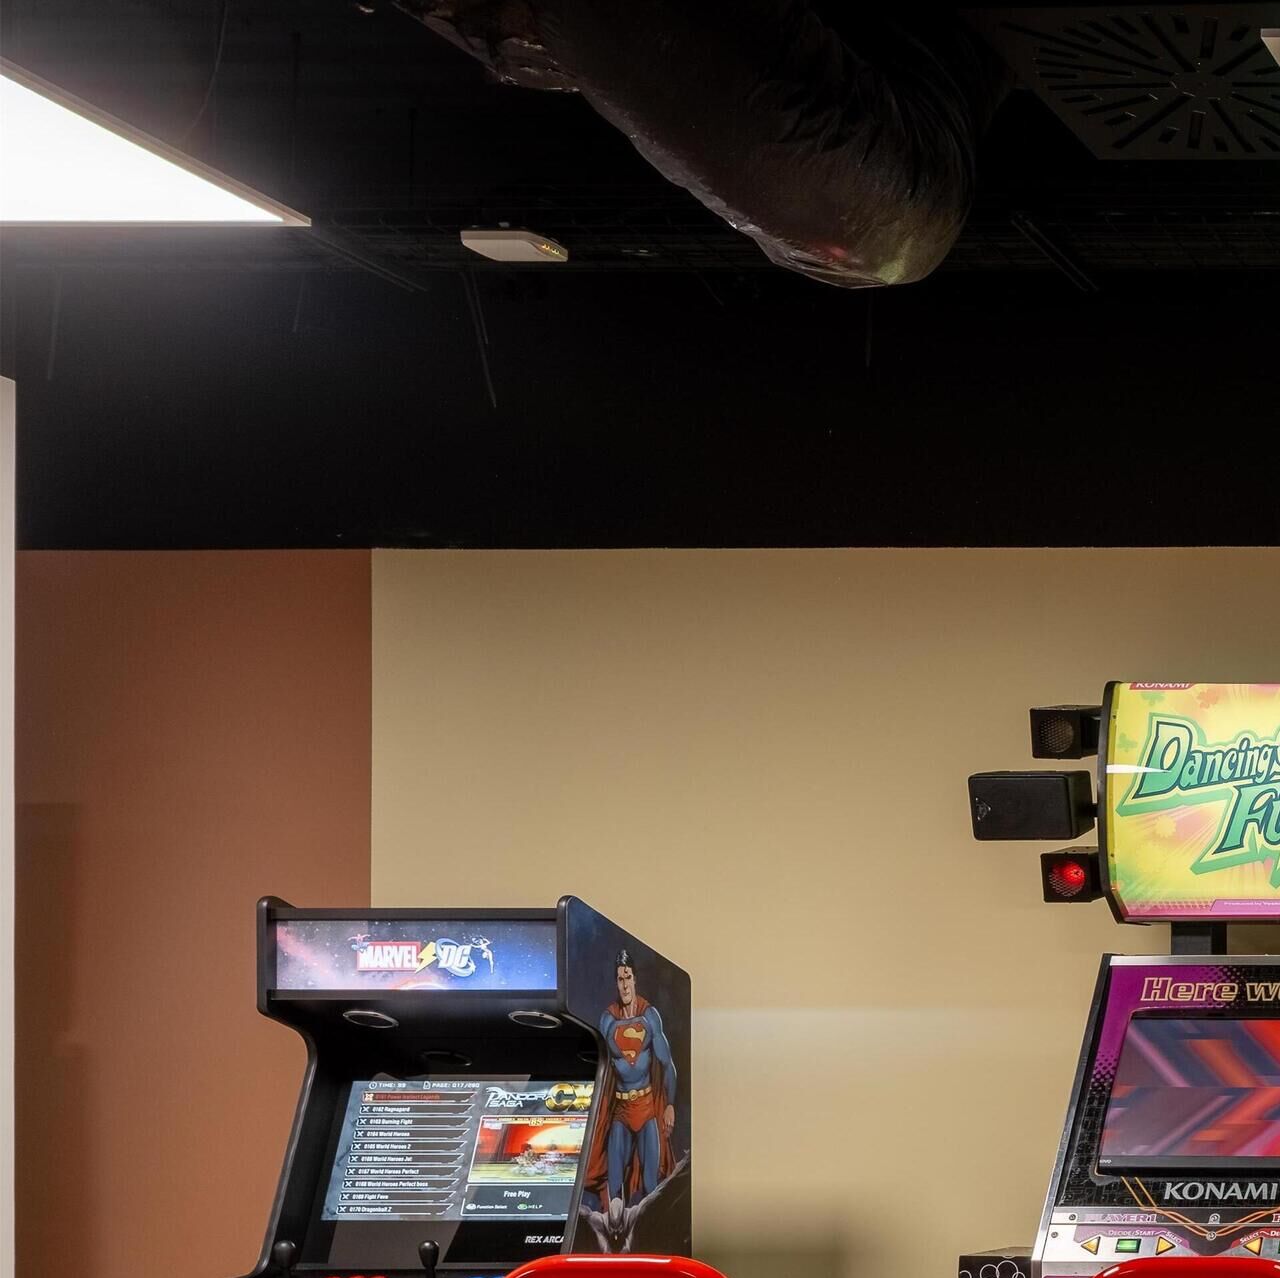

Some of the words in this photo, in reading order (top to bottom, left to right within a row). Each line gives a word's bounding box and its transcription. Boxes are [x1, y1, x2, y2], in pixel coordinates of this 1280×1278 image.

[1132, 720, 1275, 800] Dancing
[360, 945, 420, 969] MARVEL
[438, 945, 472, 969] DC
[1141, 977, 1239, 1001] Here
[504, 1190, 517, 1198] Free
[517, 1190, 531, 1199] Play
[1164, 1182, 1278, 1200] KONAMI
[525, 1235, 543, 1244] REX
[1239, 1231, 1260, 1244] SELECT
